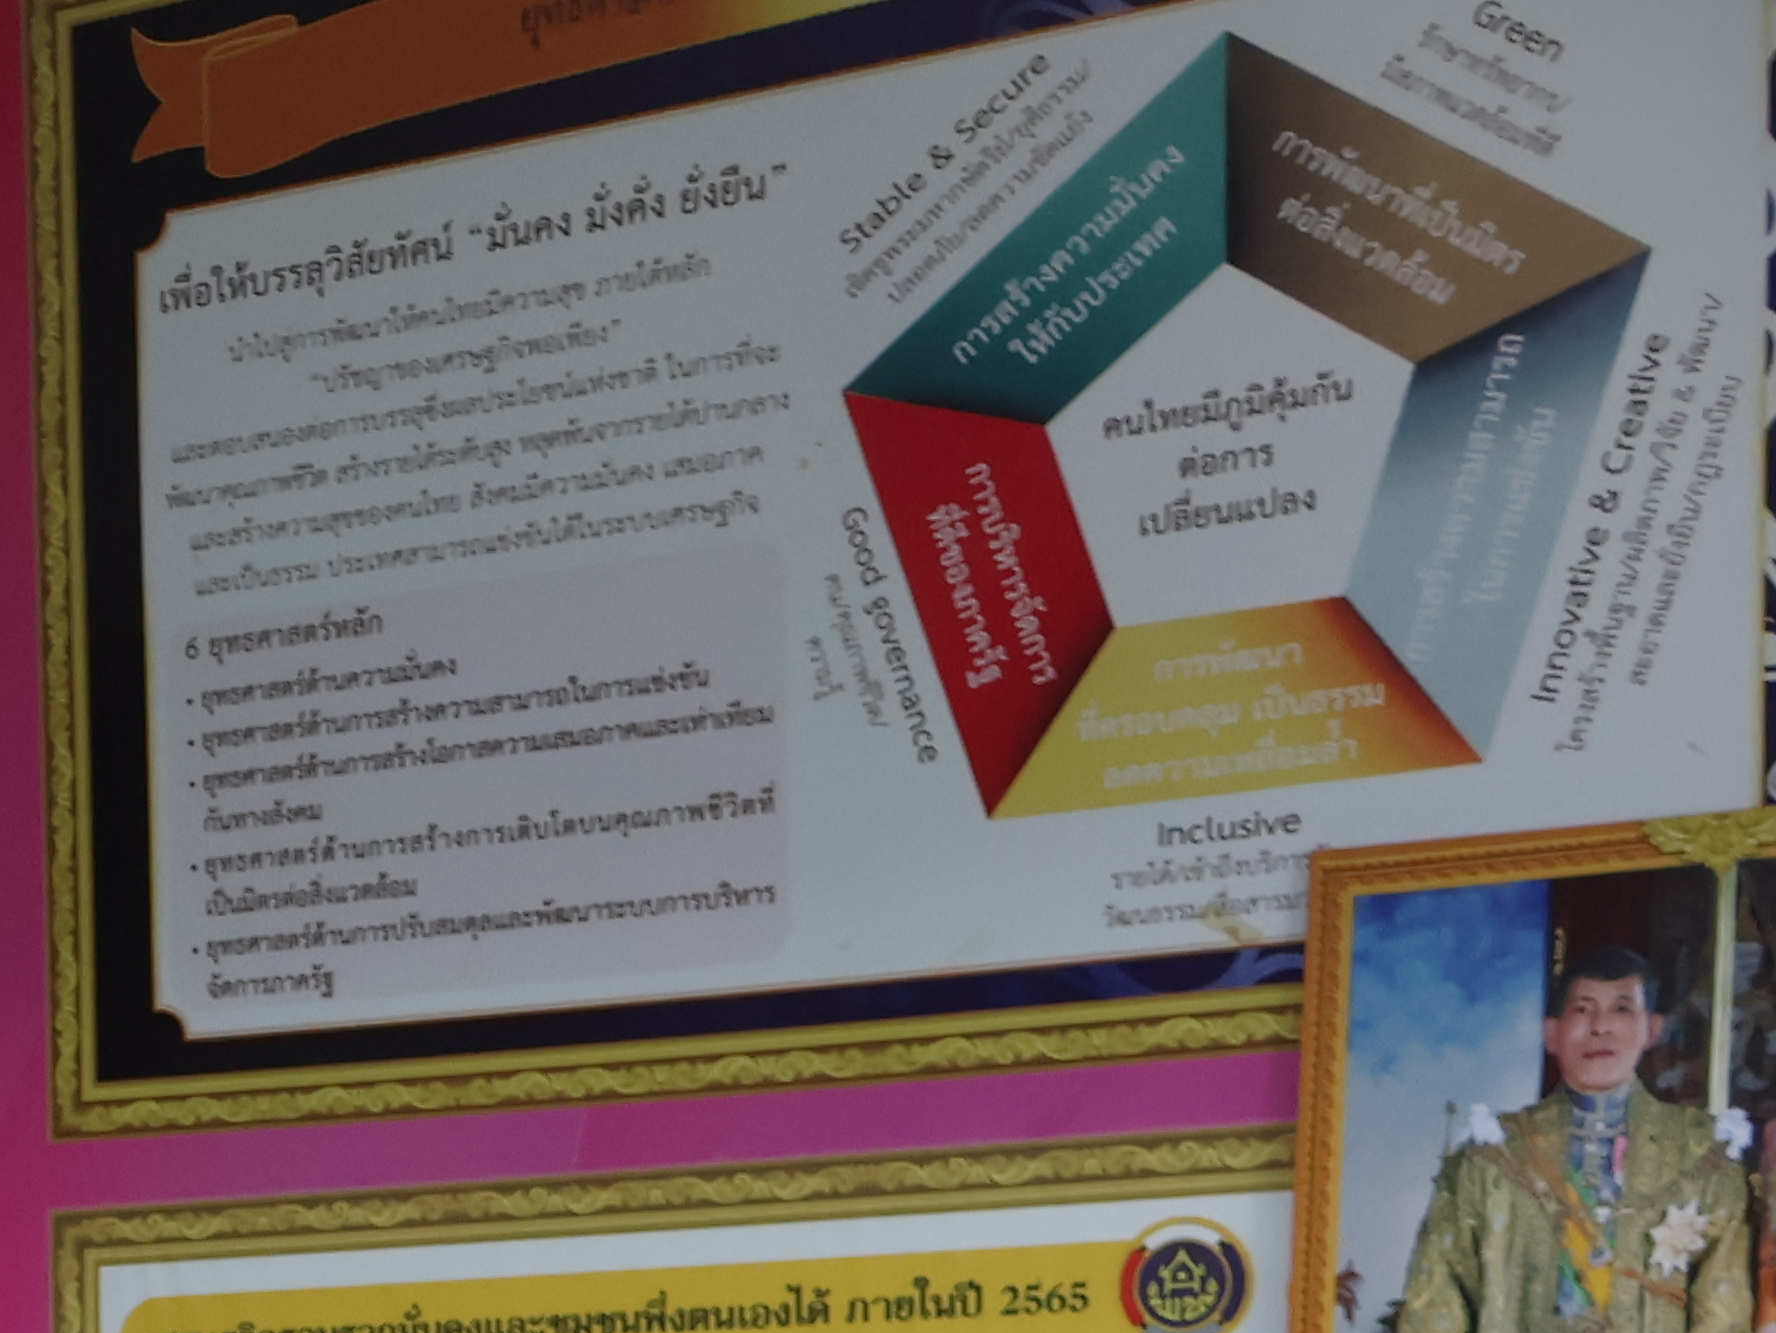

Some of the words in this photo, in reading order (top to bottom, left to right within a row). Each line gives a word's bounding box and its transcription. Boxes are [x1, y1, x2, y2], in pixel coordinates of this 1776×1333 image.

[1473, 0, 1565, 63] Green
[839, 172, 928, 254] Stable
[927, 144, 956, 171] &
[953, 53, 1052, 144] Secure
[159, 219, 454, 314] เพื่อให้บรรลุวิสัยทัศน์
[1600, 333, 1670, 476] Creative
[1178, 443, 1275, 479] ต่อการ
[1138, 487, 1318, 537] เปลี่ยนแปลง
[1588, 489, 1620, 517] &
[841, 506, 889, 587] Good
[1529, 525, 1611, 704] Innovative
[185, 637, 199, 660] 6
[861, 595, 940, 765] governance
[1156, 810, 1303, 848] Inclusive
[844, 1276, 983, 1325] ภายในปี
[999, 1280, 1090, 1317] 2565
